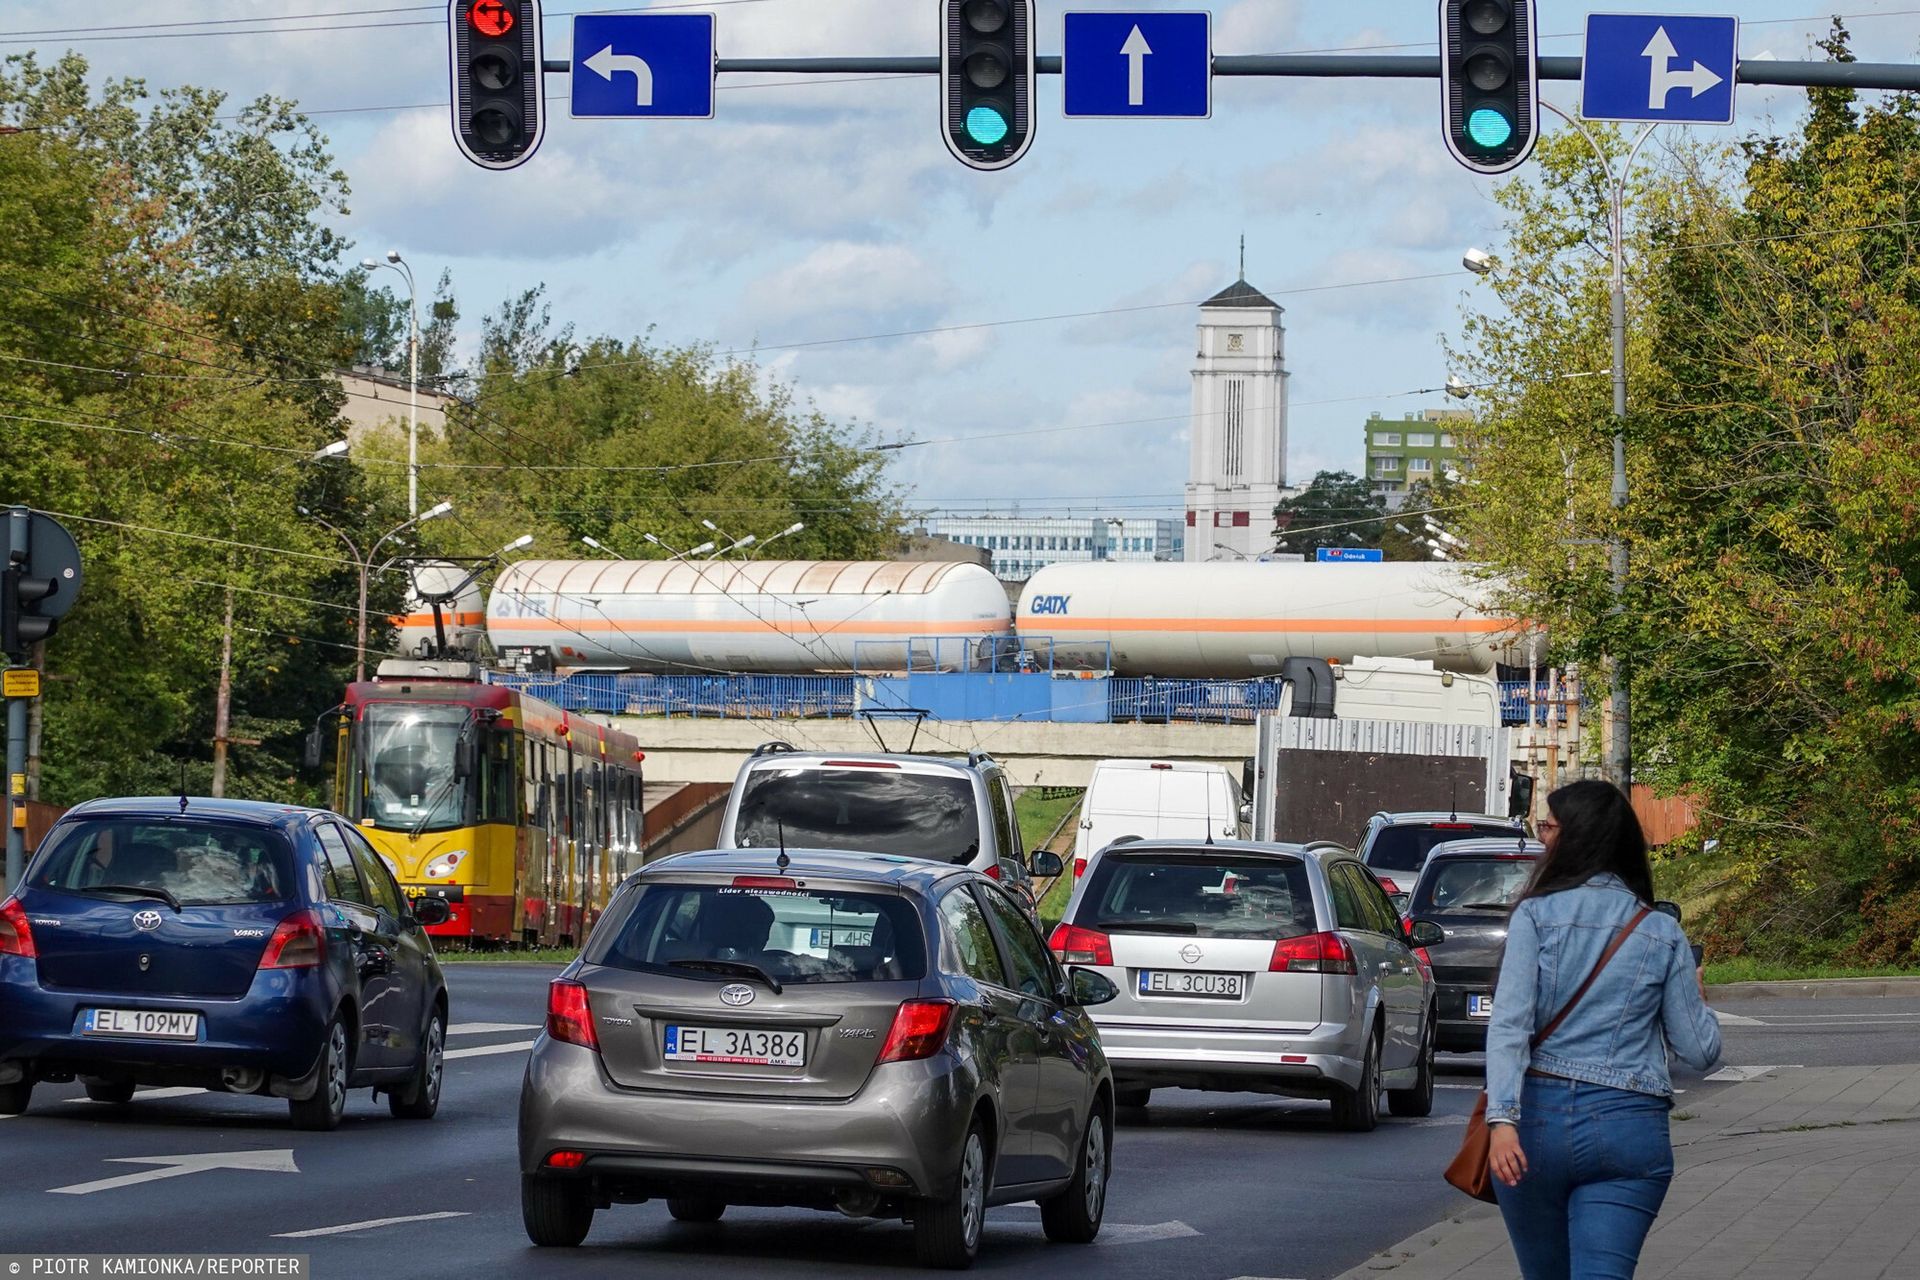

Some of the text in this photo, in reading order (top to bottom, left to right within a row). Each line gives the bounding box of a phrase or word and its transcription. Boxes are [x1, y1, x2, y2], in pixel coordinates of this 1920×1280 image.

[1031, 595, 1071, 614] GATX
[745, 889, 810, 898] niezawodności
[35, 919, 61, 927] TOYOTA
[233, 929, 264, 937] YARIS
[1152, 973, 1237, 993] EL 3CU38
[97, 1011, 194, 1034] EL 109MV
[602, 1017, 633, 1026] TOYOTA
[839, 1028, 877, 1039] YARIS
[667, 1043, 676, 1051] PL
[681, 1030, 799, 1058] EL 3A386
